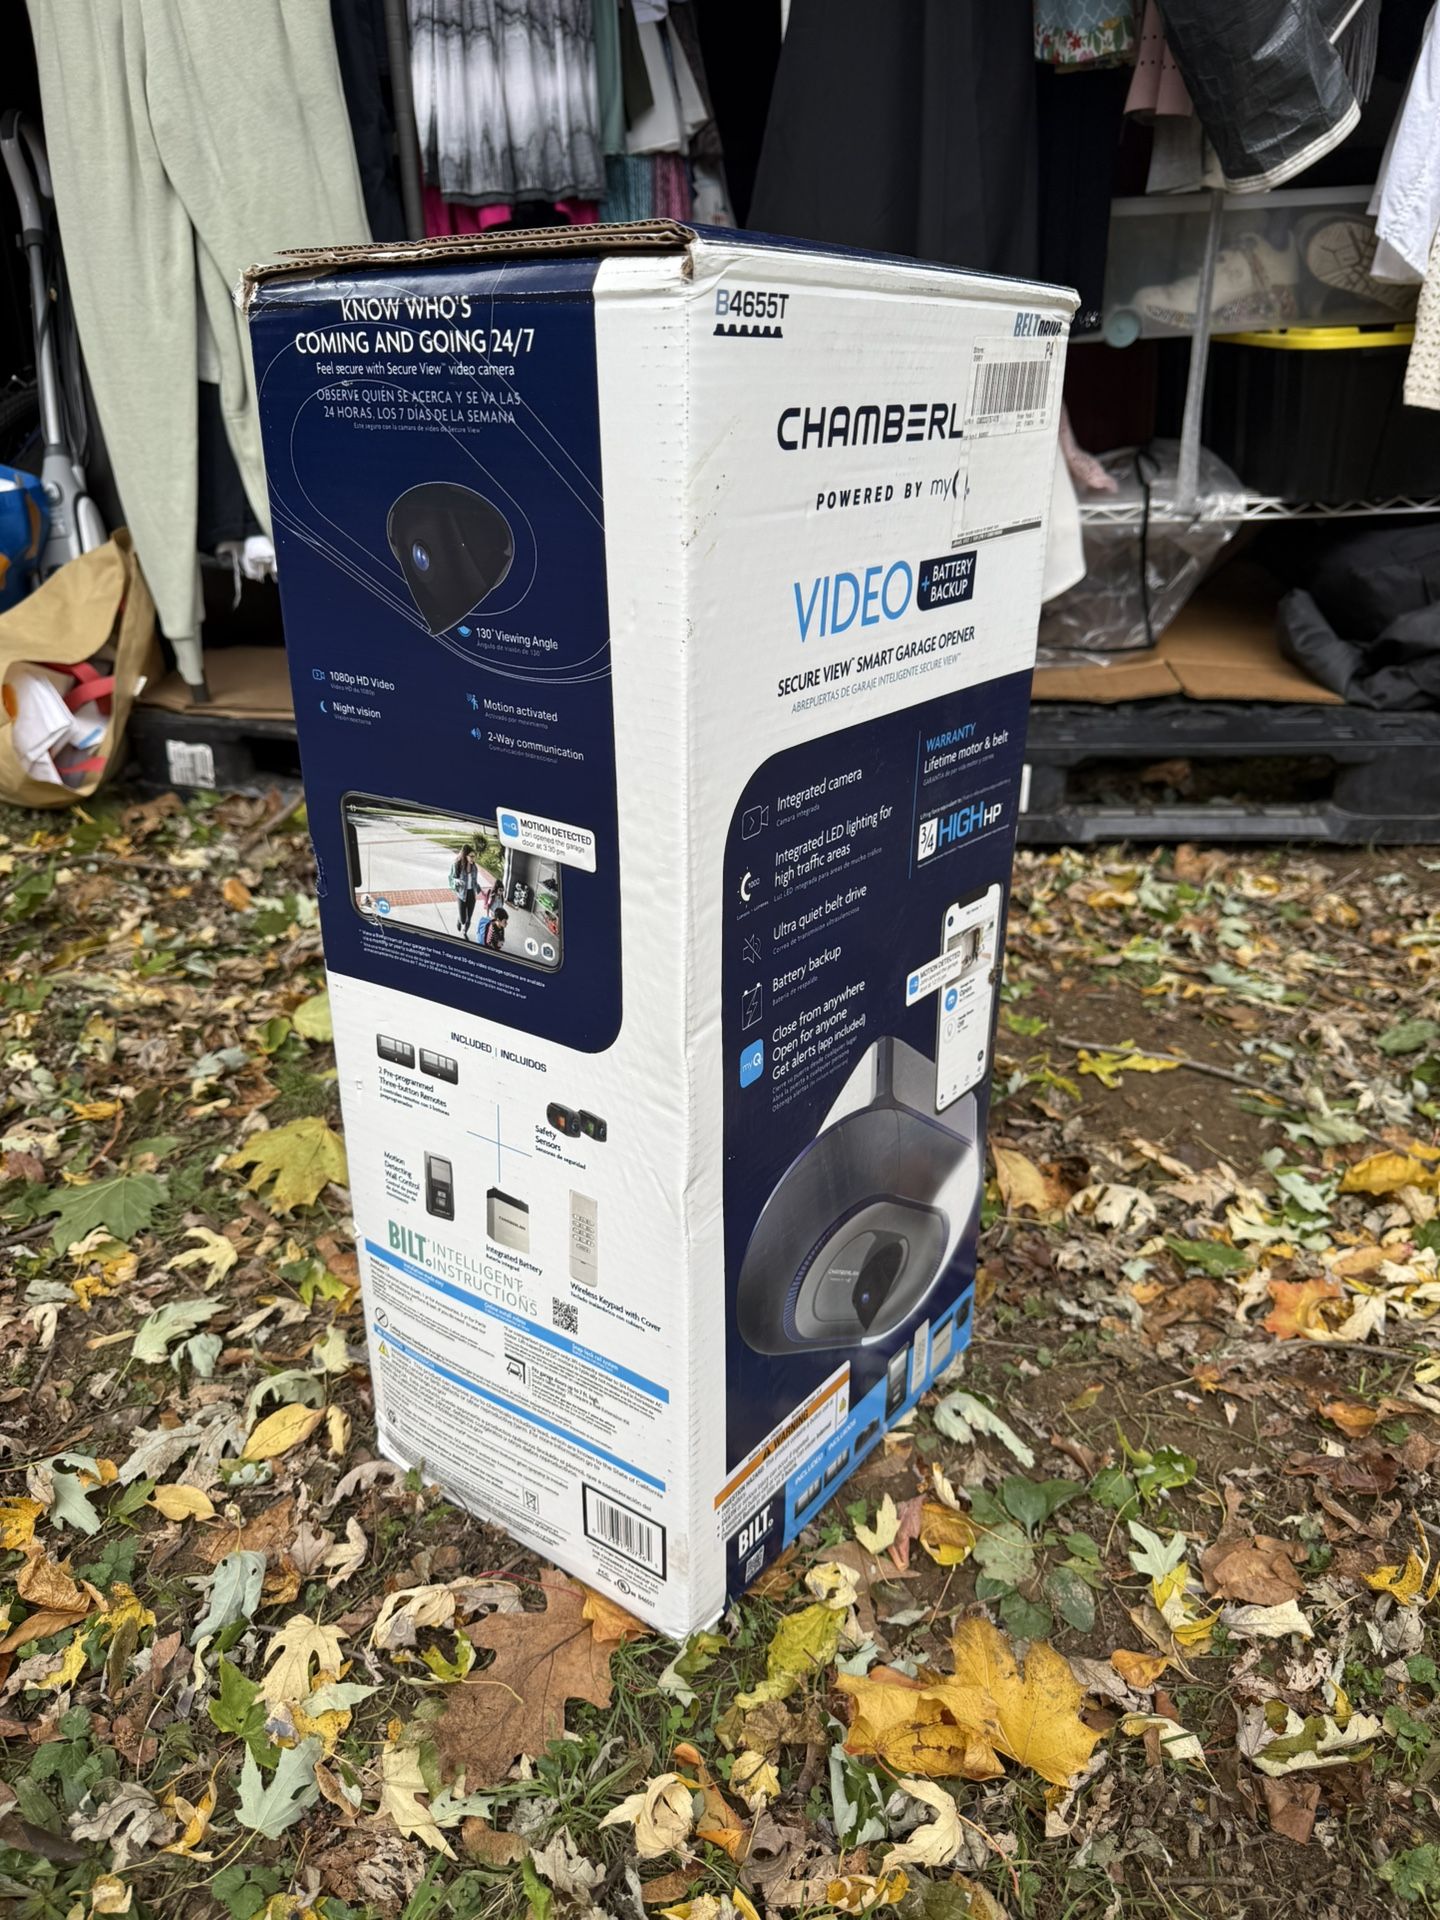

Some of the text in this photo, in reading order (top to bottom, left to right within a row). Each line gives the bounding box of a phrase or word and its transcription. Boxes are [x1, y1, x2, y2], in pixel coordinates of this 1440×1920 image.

[342, 296, 471, 320] KNOW WHO'S
[715, 289, 789, 319] B4655T
[296, 328, 535, 357] COMING AND GOING 24/7
[317, 362, 334, 375] Feel
[336, 365, 364, 375] secure
[365, 363, 385, 375] with
[387, 363, 417, 375] Secure
[449, 364, 476, 376] video
[478, 366, 515, 376] camera
[317, 386, 521, 405] OBSERVE QUIÉN SE ACERCA Y SE VA LAS
[324, 406, 335, 418] 24
[377, 408, 397, 420] LOS
[399, 408, 404, 420] 7
[407, 404, 431, 421] DÍAS
[434, 410, 449, 422] DE
[451, 410, 465, 422] LA
[467, 411, 515, 424] SEMANA
[777, 403, 963, 451] CHAMBERL
[817, 487, 894, 510] POWERED
[905, 482, 922, 498] BY
[932, 558, 973, 582] BATTERY
[794, 560, 913, 643] VIDEO
[930, 579, 968, 602] BACKUP
[496, 630, 531, 648] Viewing
[532, 636, 558, 651] Angle
[778, 668, 821, 697] SECURE
[857, 649, 894, 673] SMART
[896, 635, 937, 661] GARAGE
[938, 626, 975, 649] OPENER
[330, 672, 395, 691] 1080p HD Video
[791, 688, 840, 714] ABREPUERTAS
[841, 686, 850, 697] DE
[851, 676, 877, 694] GARAJE
[878, 665, 919, 688] INTELIGENTE
[919, 657, 942, 674] SECURE
[333, 702, 381, 718] Night vision
[484, 699, 514, 714] Motion
[516, 706, 558, 721] activated
[488, 732, 515, 748] 2-Way
[517, 739, 584, 760] communication
[924, 752, 957, 774] Lifetime
[958, 741, 983, 760] motor
[984, 736, 990, 749] &
[992, 729, 1008, 746] belt
[927, 722, 976, 752] WARRANTY
[778, 769, 862, 811] Integrated camera
[521, 819, 591, 845] MOTION DETECTED
[775, 805, 893, 866] Integrated LED lighting for
[938, 801, 985, 847] HIGH
[775, 843, 850, 887] high traffic areas
[774, 921, 796, 940] Ultra
[799, 905, 823, 930] quiet
[825, 894, 843, 914] belt
[845, 886, 867, 904] drive
[773, 946, 841, 992] Battery backup
[773, 981, 865, 1042] Close from anywhere
[773, 1009, 847, 1061] Open for anyone
[773, 1013, 866, 1080] Get alerts (app included)
[450, 1031, 547, 1073] INCLUDED INCLUIDOS
[742, 1052, 762, 1072] myQ
[380, 1076, 419, 1097] Three-button
[420, 1091, 447, 1107] Remotes
[384, 1068, 434, 1093] Pre-programmed
[536, 1125, 556, 1141] Safety
[536, 1136, 561, 1151] Sensors
[384, 1151, 405, 1165] Motion
[384, 1160, 412, 1180] Detecting
[385, 1169, 420, 1190] Wall Control
[433, 1241, 523, 1292] INTELLIGENT
[486, 1244, 543, 1276] Integrated Battery
[433, 1258, 537, 1316] INSTRUCTIONS
[570, 1281, 598, 1301] Wireless
[599, 1295, 623, 1313] Keypad
[625, 1310, 640, 1322] with
[641, 1317, 661, 1332] Cover
[774, 1409, 808, 1448] WARNING
[795, 1452, 823, 1485] INCLUDED
